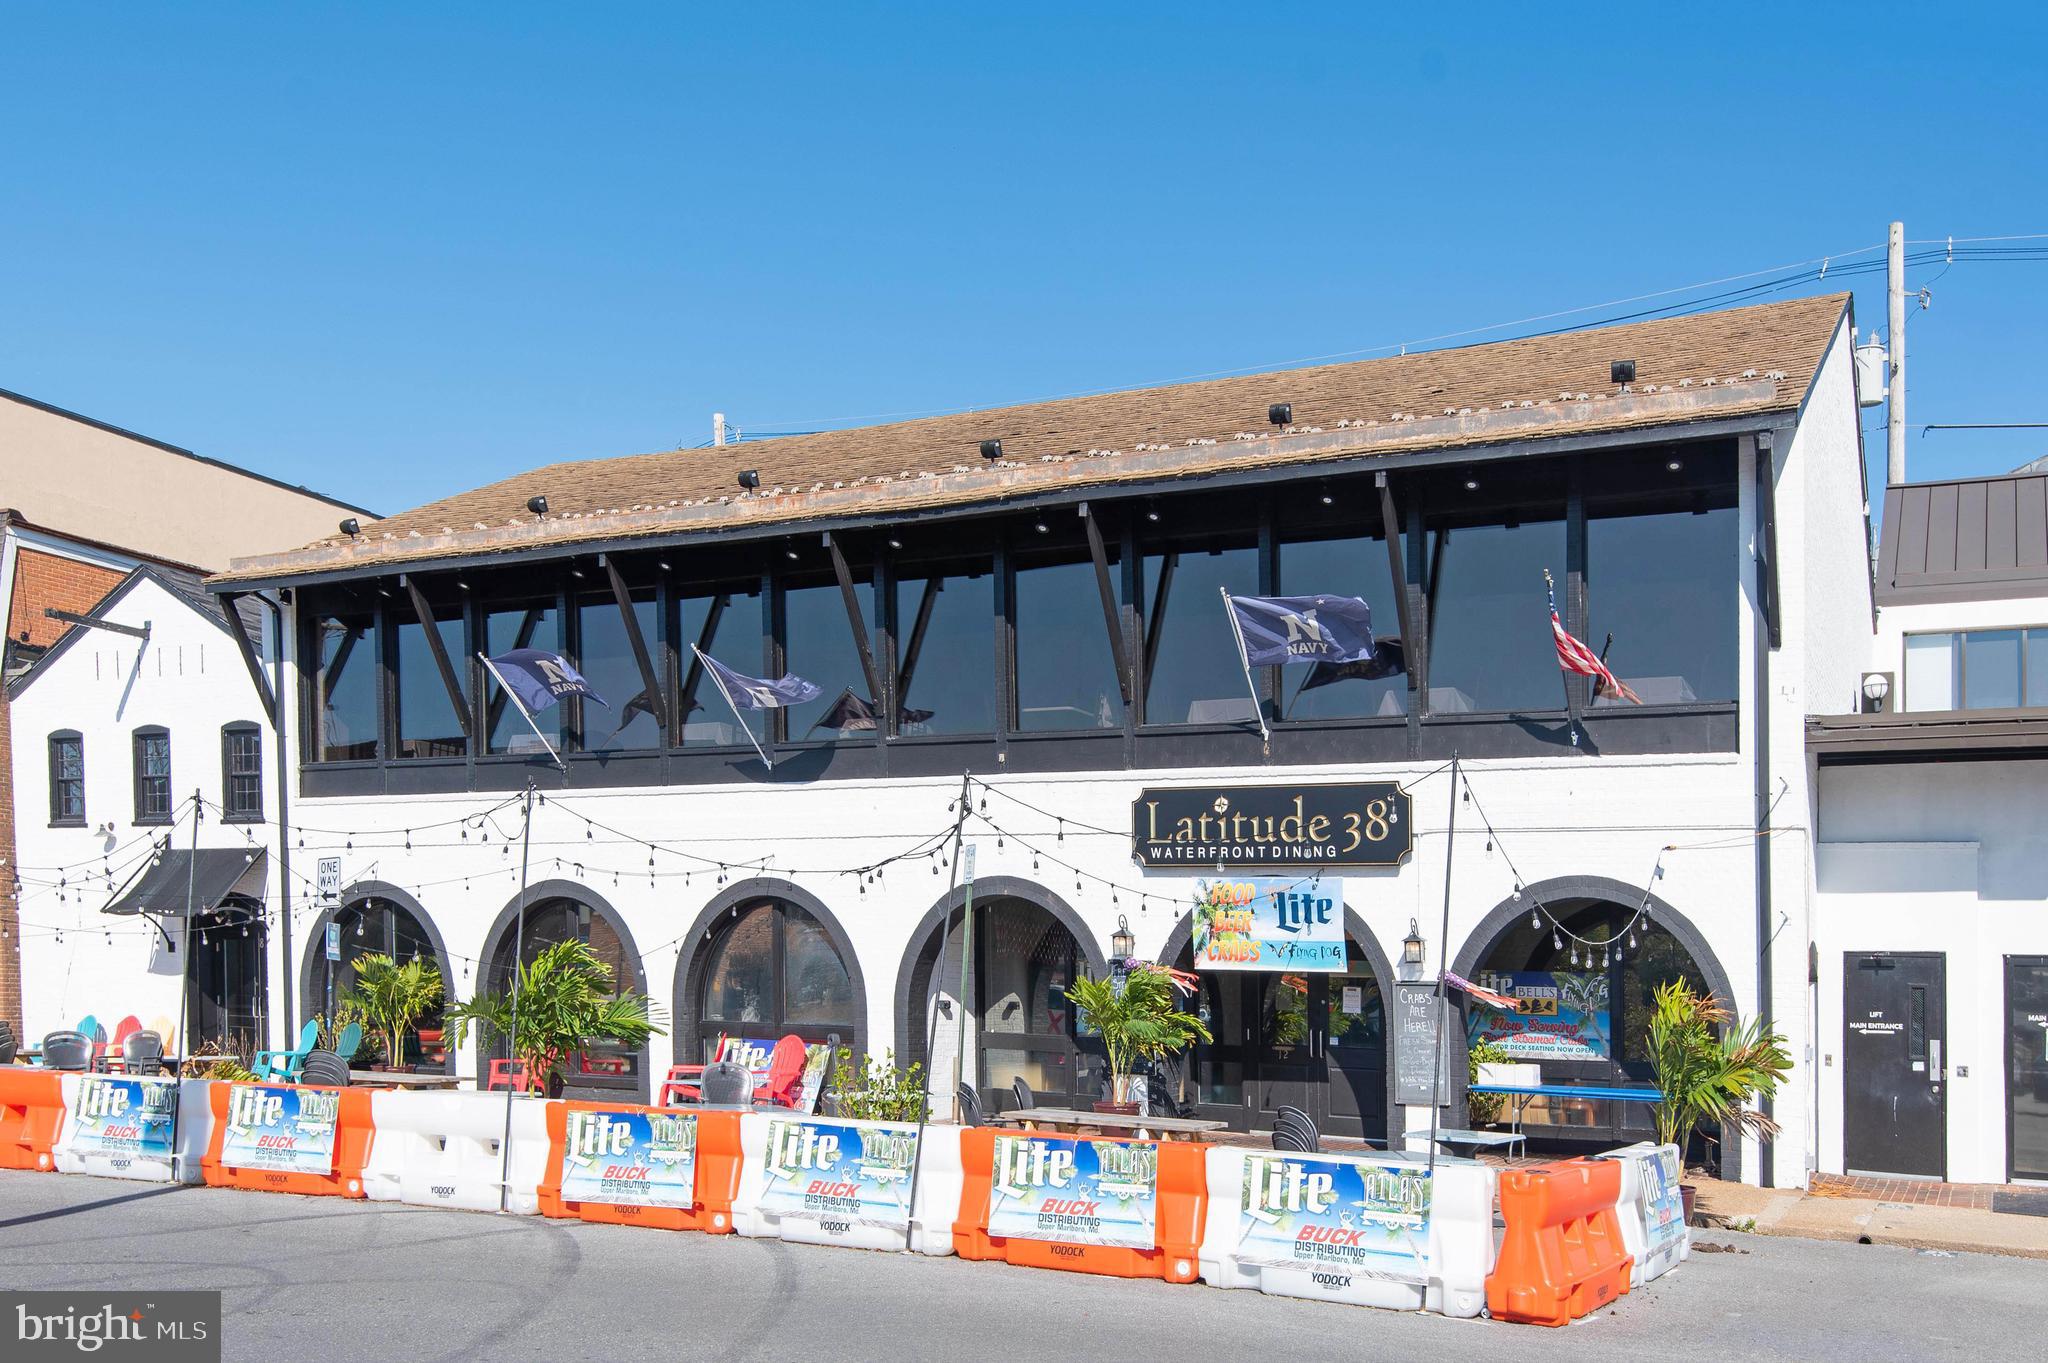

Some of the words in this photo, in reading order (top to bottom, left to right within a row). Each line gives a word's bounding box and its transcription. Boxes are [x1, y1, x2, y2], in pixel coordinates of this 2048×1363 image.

[1287, 643, 1328, 656] NAVY
[551, 682, 584, 695] NAVY
[1146, 793, 1331, 844] Latitude
[1151, 846, 1266, 859] WATERFRONT
[1272, 845, 1337, 858] DINNG
[320, 861, 338, 874] ONE
[320, 875, 338, 887] WAY
[1211, 882, 1256, 906] FOOD
[1213, 910, 1254, 933] BEER
[1275, 892, 1333, 934] Lite
[1207, 940, 1262, 962] CRABS
[1480, 973, 1513, 997] ite
[1400, 988, 1432, 1005] CRABS
[1409, 1005, 1427, 1018] ARE
[2028, 1014, 2047, 1022] MAIN
[1490, 1016, 1524, 1031] Now
[1528, 1018, 1579, 1036] Serving
[1868, 1022, 1904, 1030] ENTRANCE
[76, 1079, 128, 1126] Lite
[142, 1087, 173, 1112] ATLAS
[301, 1095, 335, 1122] ATLAS
[226, 1087, 283, 1136] Lite
[103, 1125, 141, 1138] BUCK
[565, 1113, 631, 1167] Lite
[653, 1119, 692, 1149] ATLAS
[257, 1135, 299, 1149] BUCK
[766, 1122, 839, 1181] Lite
[863, 1135, 909, 1168] ATLAS
[603, 1166, 652, 1180] BUCK
[993, 1137, 1073, 1199] Lite
[1100, 1147, 1151, 1183] ATLAS
[430, 1186, 456, 1195] YODOCK
[601, 1179, 651, 1190] DISTRIBUTING
[806, 1180, 862, 1198] BUCK
[1243, 1155, 1333, 1224] Lite
[1364, 1172, 1424, 1213] ATLAS
[614, 1205, 641, 1214] YODOCK
[804, 1194, 861, 1208] DISTRIBUTING
[1040, 1198, 1101, 1216] BUCK
[819, 1221, 851, 1232] YODOCK
[1038, 1213, 1101, 1227] DISTRIBUTING
[1296, 1225, 1367, 1246] BUCK
[1050, 1245, 1085, 1257] YODOCK
[1294, 1240, 1367, 1258] DISTRIBUTING
[1311, 1272, 1352, 1287] YODOCK
